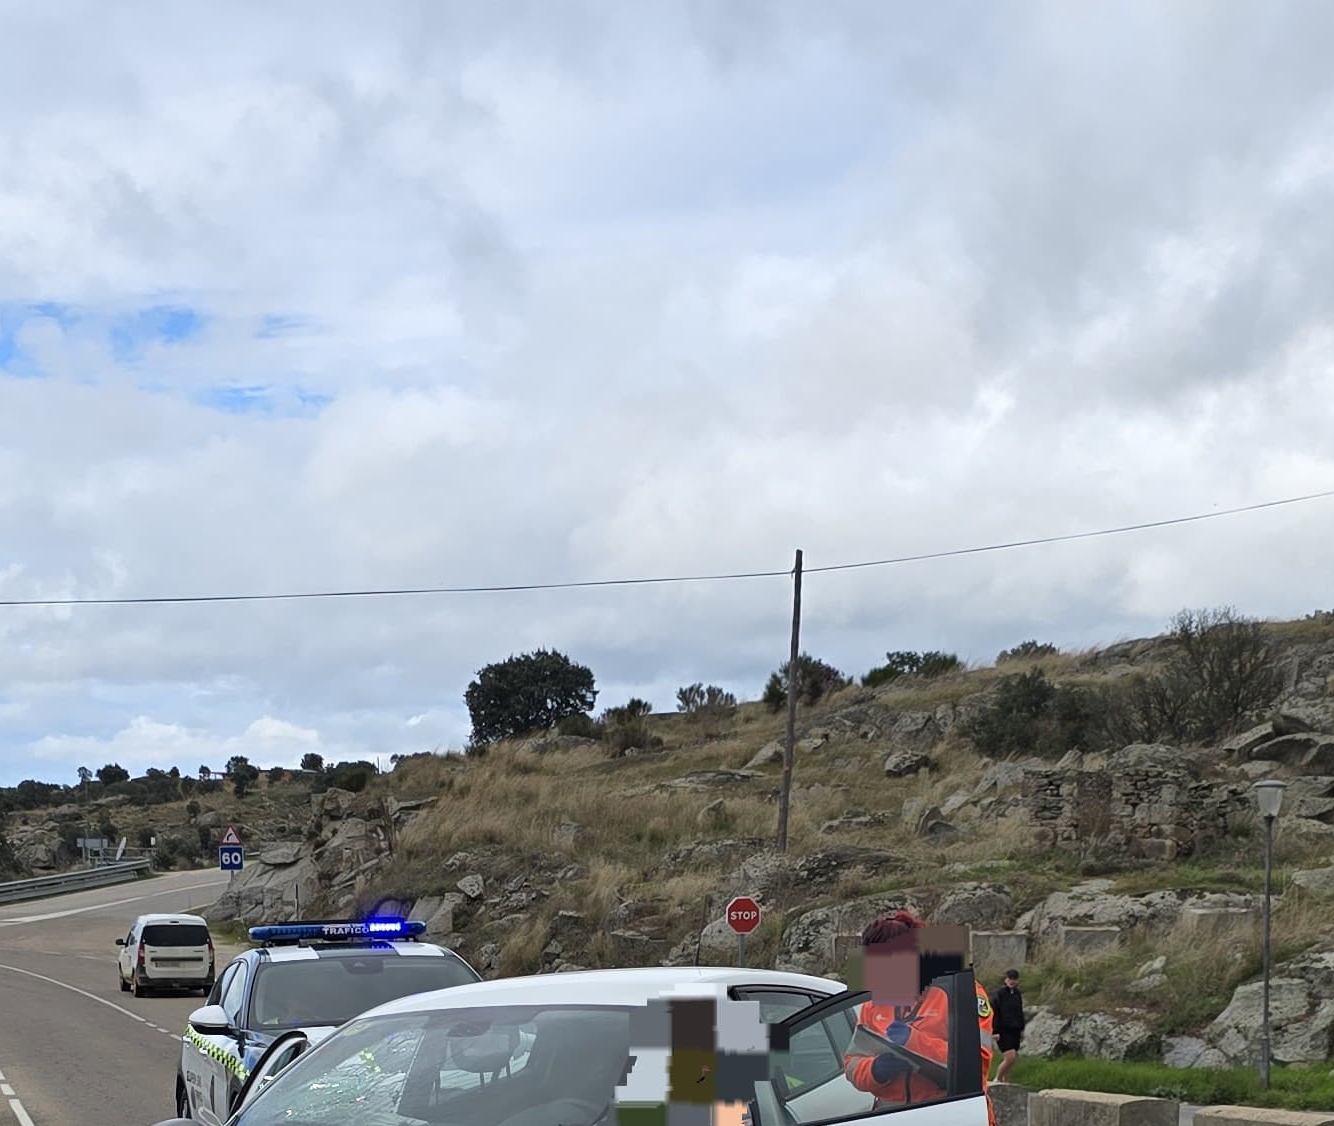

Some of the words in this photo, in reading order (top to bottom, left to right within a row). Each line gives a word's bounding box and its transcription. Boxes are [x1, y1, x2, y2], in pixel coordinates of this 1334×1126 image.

[222, 852, 242, 865] 60
[730, 911, 757, 921] STOP
[322, 926, 370, 935] TRAFICO
